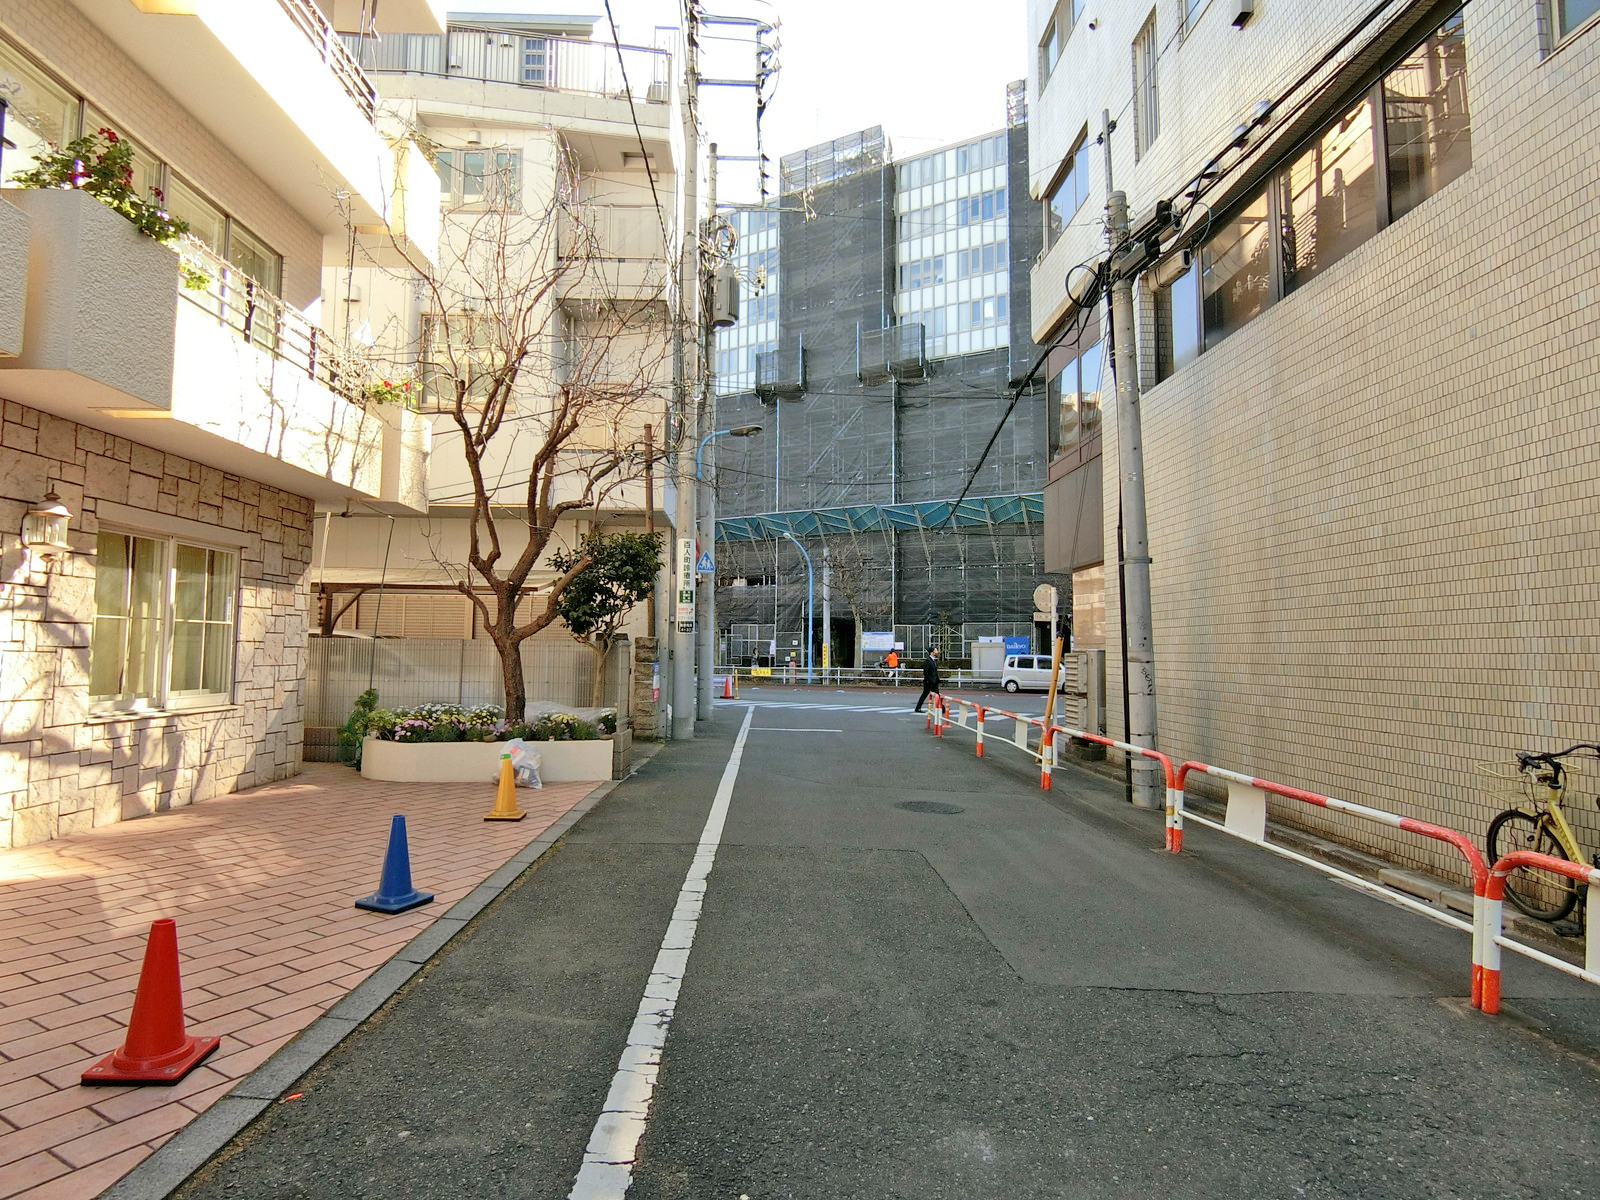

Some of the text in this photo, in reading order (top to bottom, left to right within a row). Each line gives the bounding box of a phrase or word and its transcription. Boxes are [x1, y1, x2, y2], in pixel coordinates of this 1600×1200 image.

[683, 541, 691, 587] 百人町診療所
